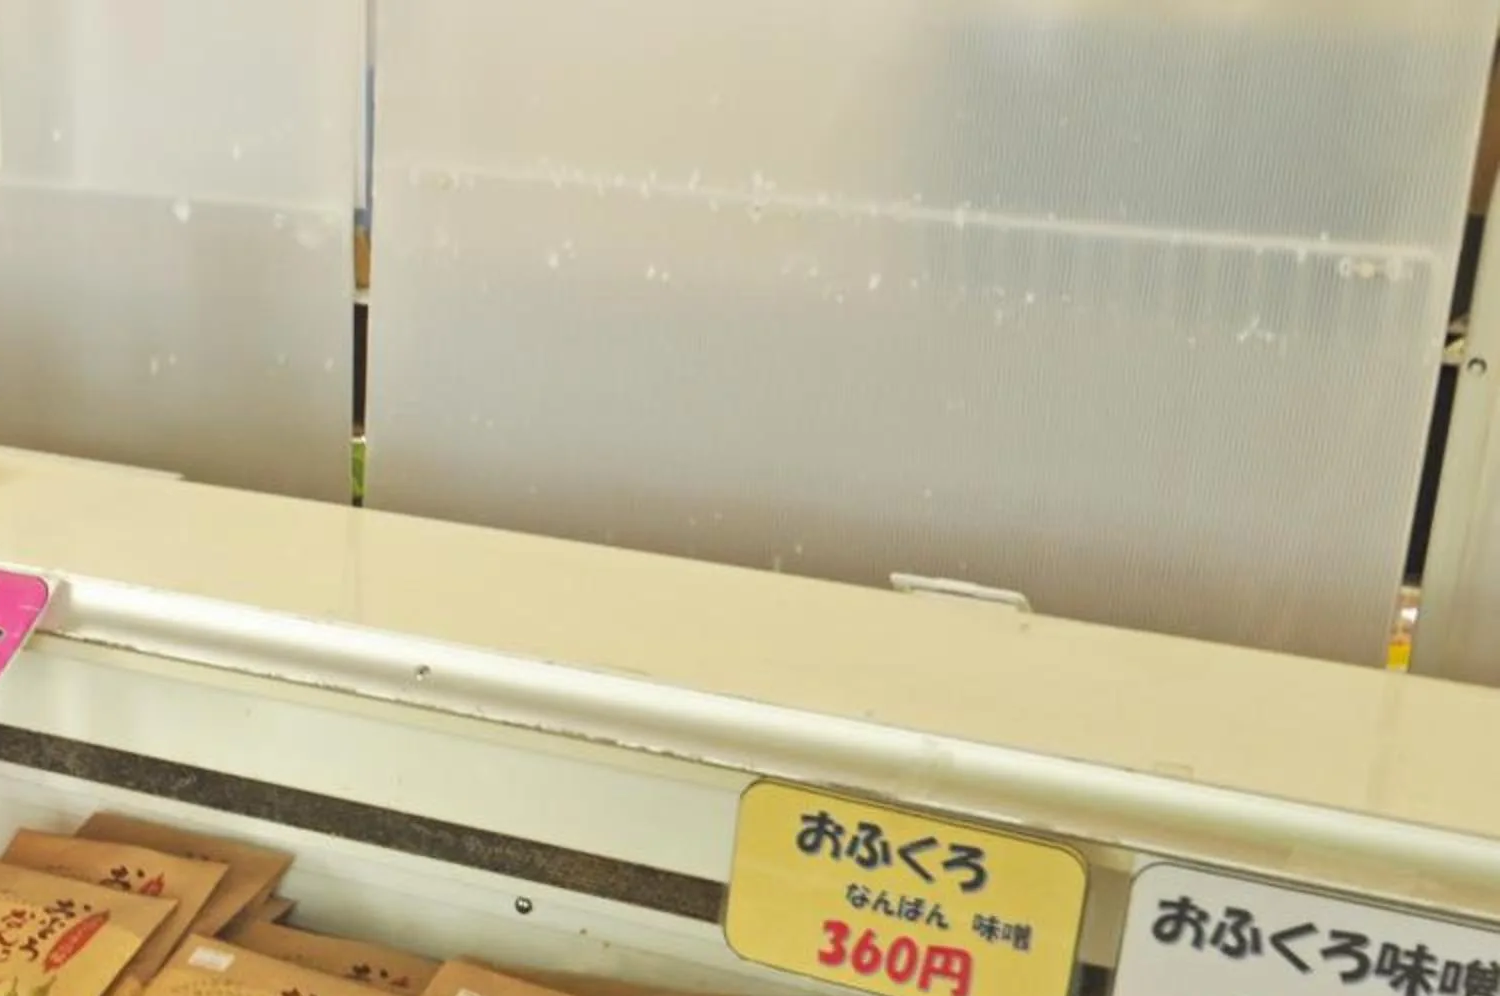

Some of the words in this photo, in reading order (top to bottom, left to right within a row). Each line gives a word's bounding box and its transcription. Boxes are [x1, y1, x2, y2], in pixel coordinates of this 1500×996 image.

[796, 810, 989, 893] おふくろ
[846, 882, 950, 931] なんばん
[972, 913, 1033, 951] 味噌
